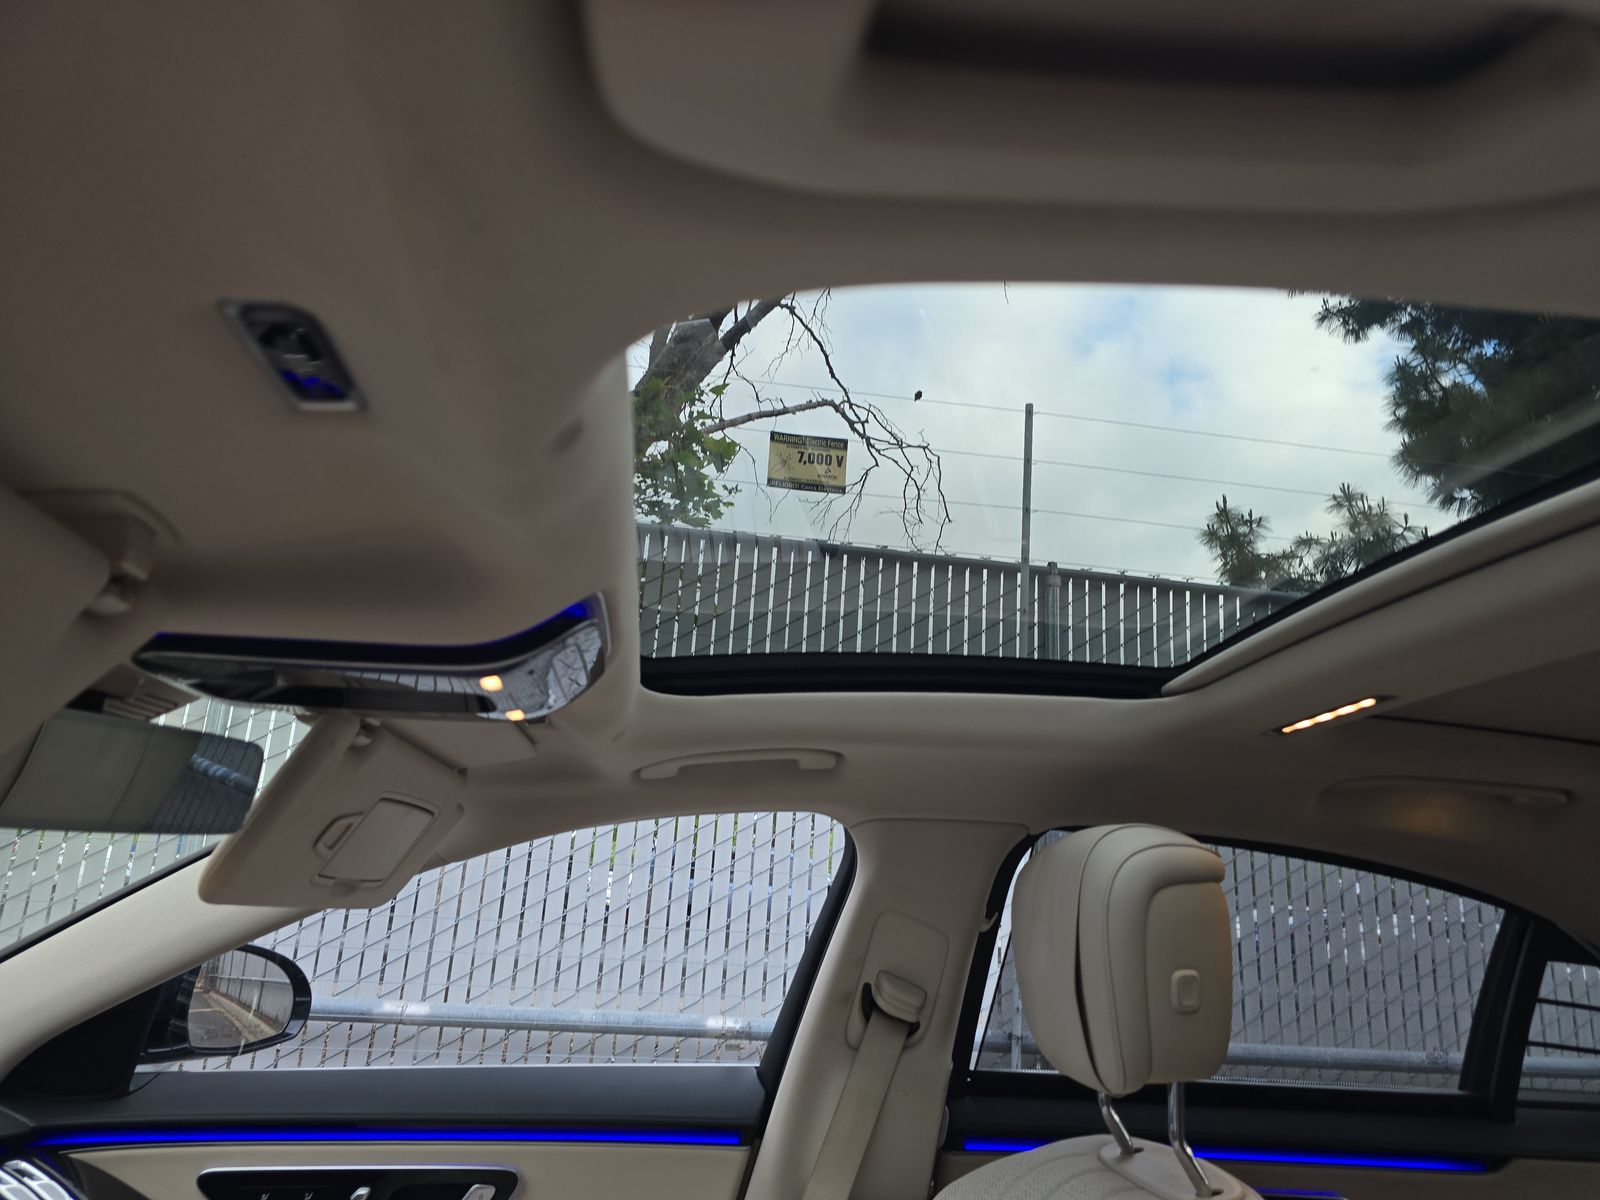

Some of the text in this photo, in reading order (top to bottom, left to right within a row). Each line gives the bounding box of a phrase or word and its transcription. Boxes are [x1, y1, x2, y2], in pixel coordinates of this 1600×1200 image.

[774, 433, 804, 446] WARNING!
[797, 451, 844, 468] 7,000 V
